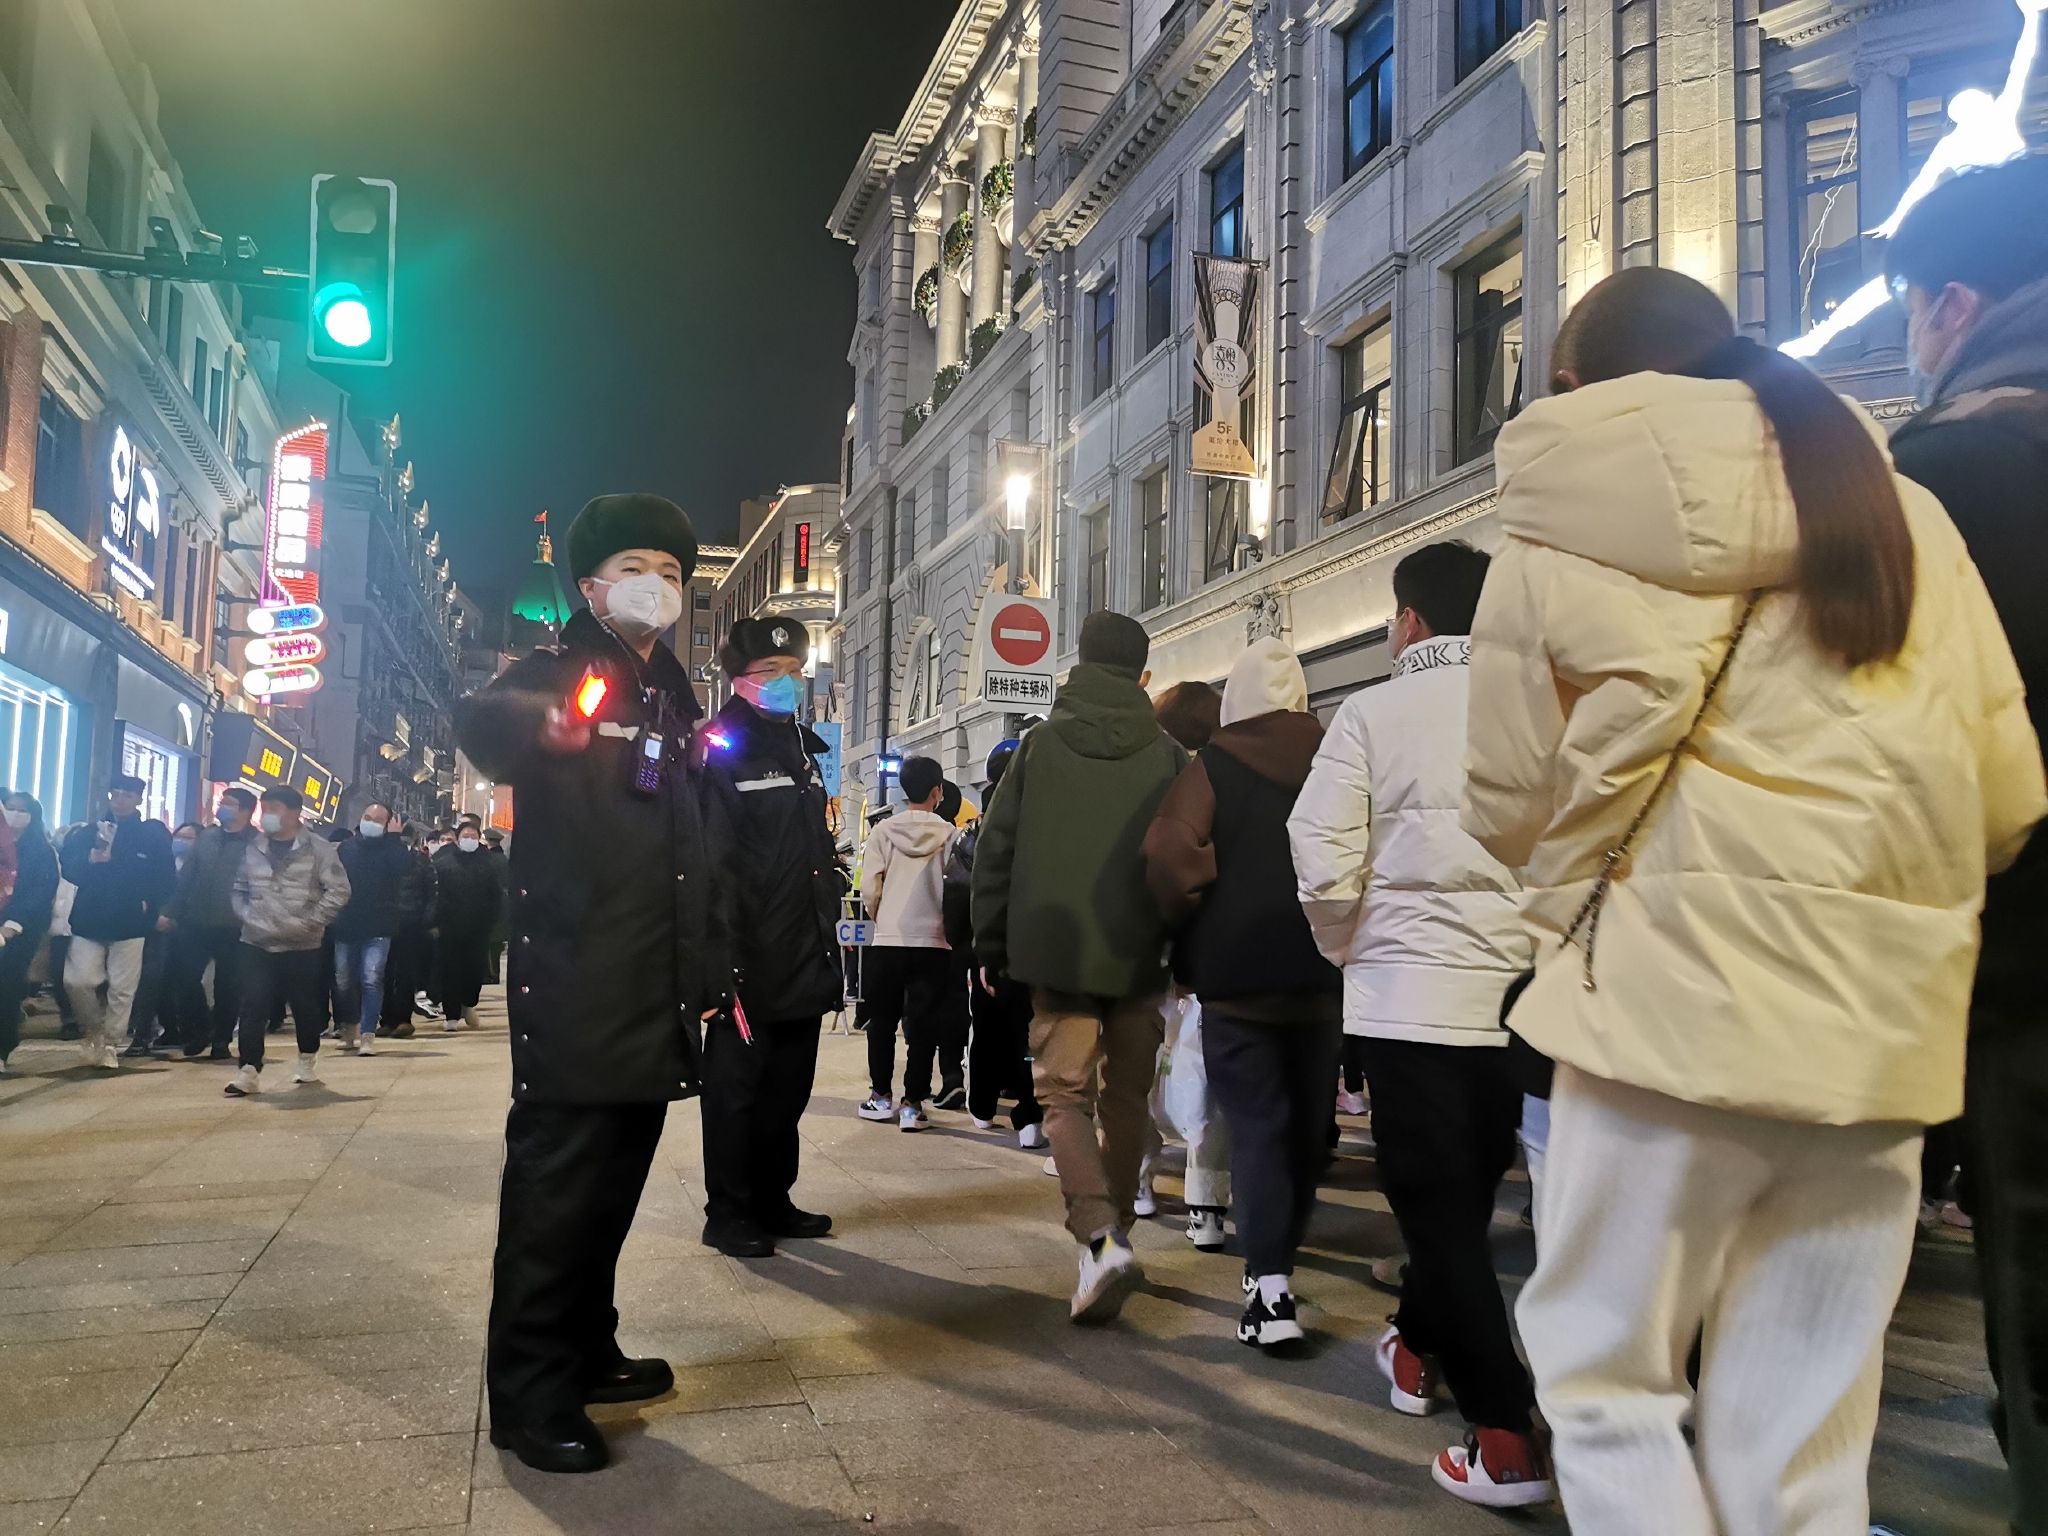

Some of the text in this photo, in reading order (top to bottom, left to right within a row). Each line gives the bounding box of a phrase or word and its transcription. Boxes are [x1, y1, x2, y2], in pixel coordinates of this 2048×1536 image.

[1217, 421, 1233, 435] 5F
[989, 676, 1050, 700] 除特种车辆外
